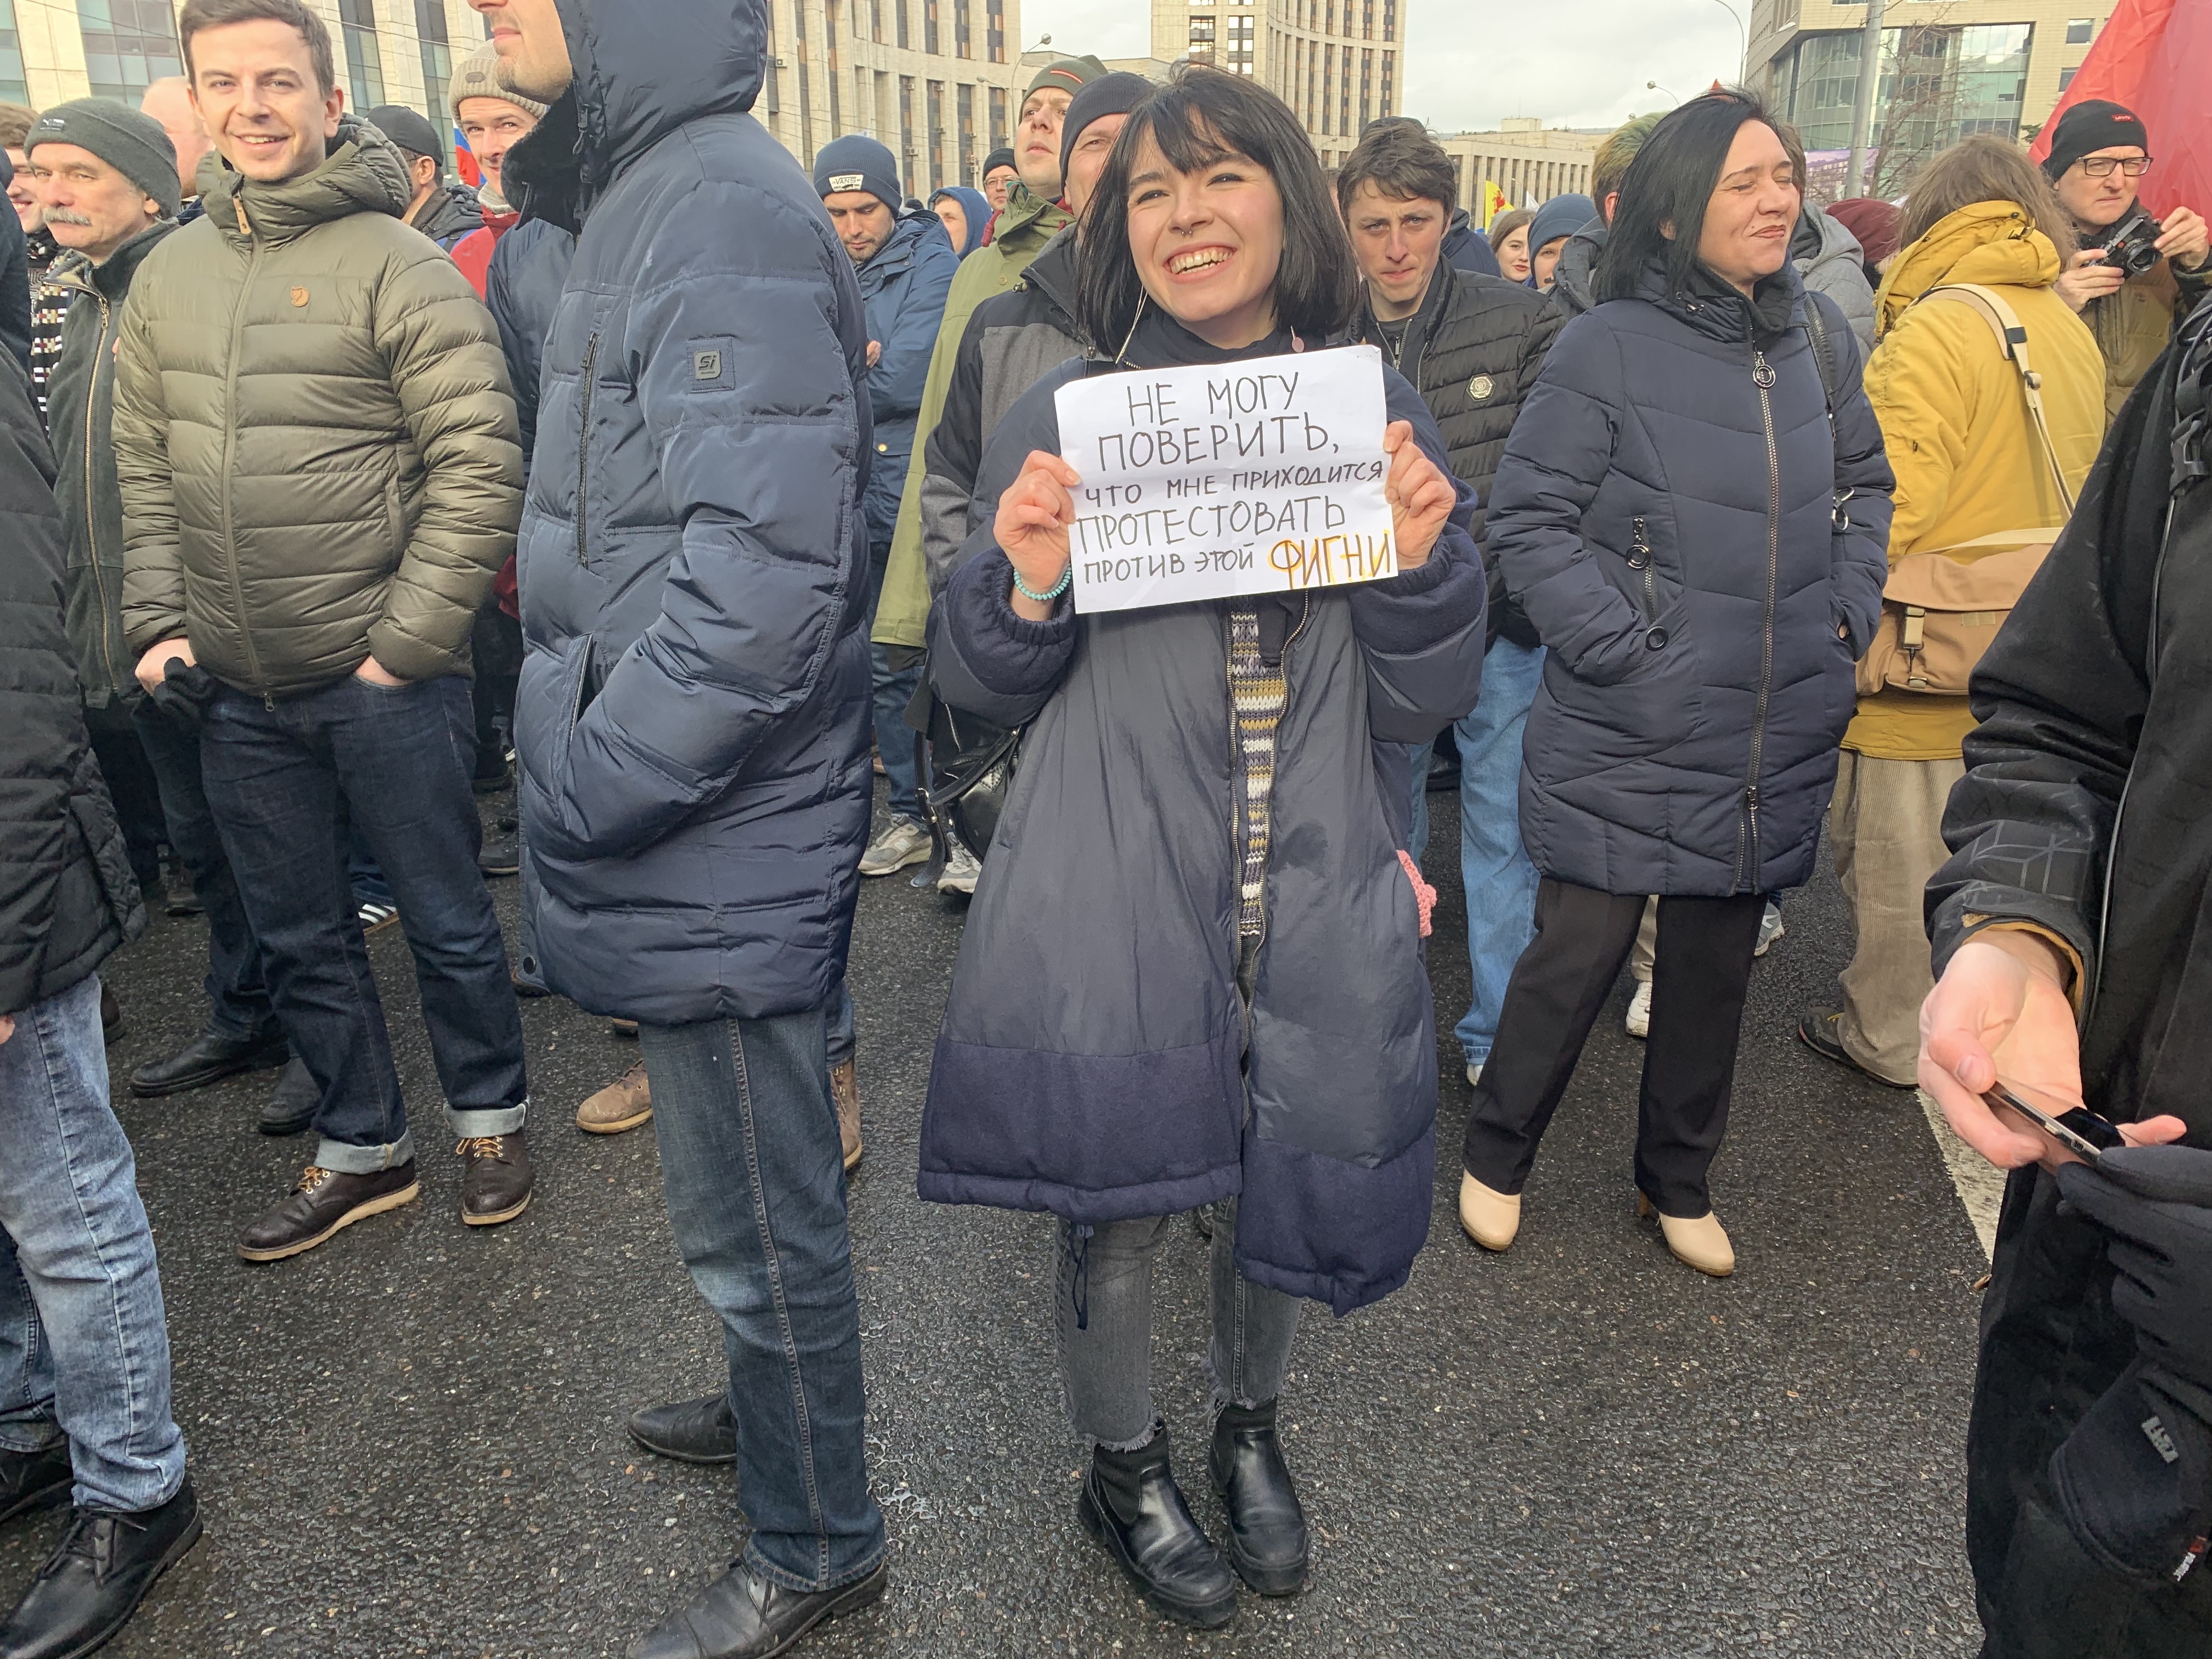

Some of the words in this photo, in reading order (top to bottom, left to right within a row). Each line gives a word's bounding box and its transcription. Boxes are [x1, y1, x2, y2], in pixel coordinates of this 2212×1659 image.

[1127, 382, 1180, 427] НЕ
[1207, 371, 1299, 420] МОГУ
[1098, 411, 1340, 472] ПОВЕРИТЬ,
[1085, 484, 1142, 508] ЧТО
[1166, 475, 1218, 499] МНЕ
[1232, 460, 1383, 492] ПРИХОДИТСЯ
[1076, 495, 1345, 555] ПРОТЕСТОВАТЬ
[1084, 552, 1185, 584] ПРОТИВ
[1194, 542, 1255, 573] ЭТОЙ
[1269, 530, 1391, 589] ФИГНИ
